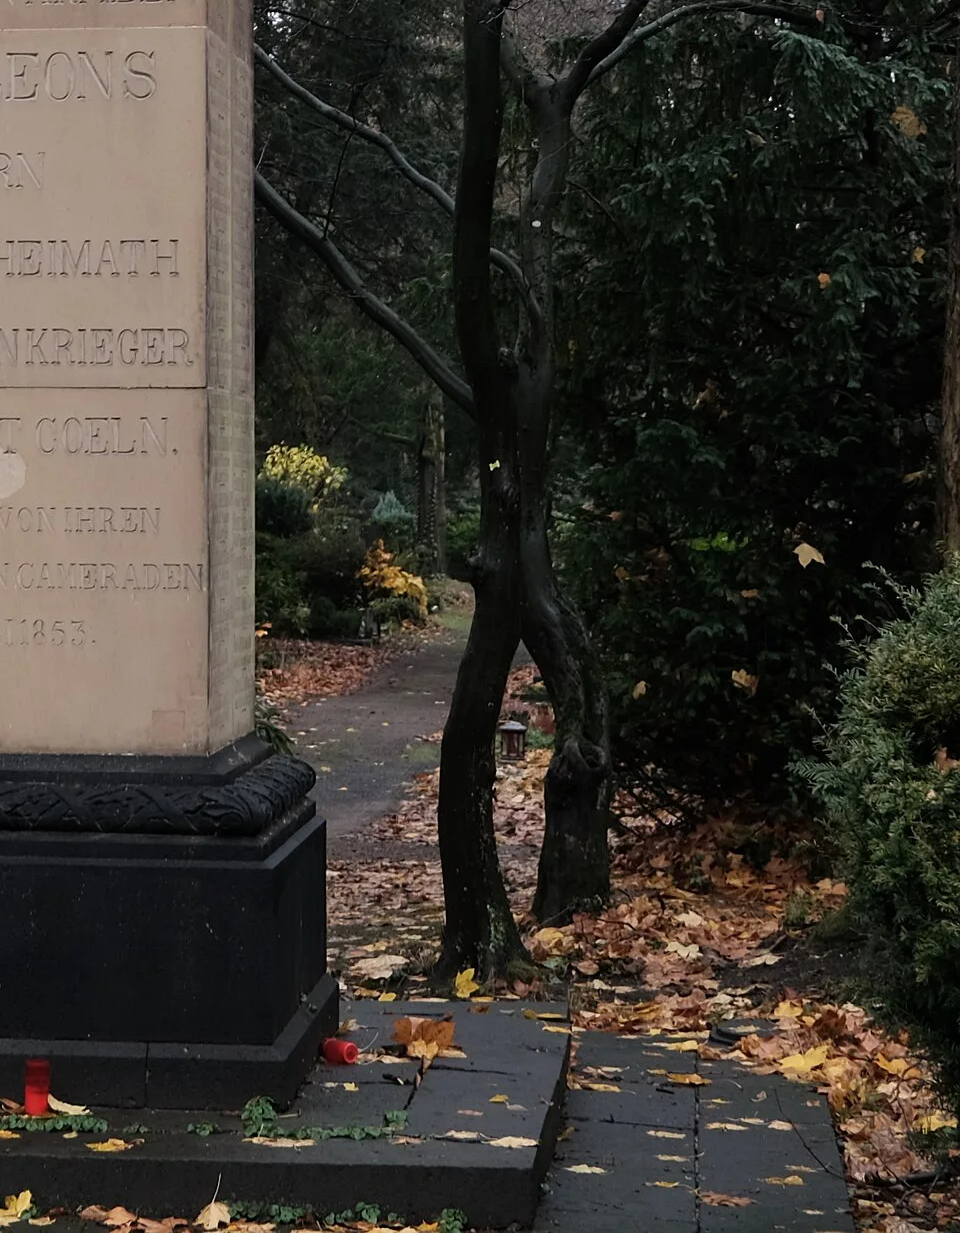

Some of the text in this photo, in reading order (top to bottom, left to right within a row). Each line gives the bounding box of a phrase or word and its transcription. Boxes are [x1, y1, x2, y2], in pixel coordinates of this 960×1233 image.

[25, 327, 194, 366] KRIEGER
[35, 416, 179, 456] COELN.
[63, 506, 161, 534] IHREN
[16, 561, 204, 592] CAMERADEN
